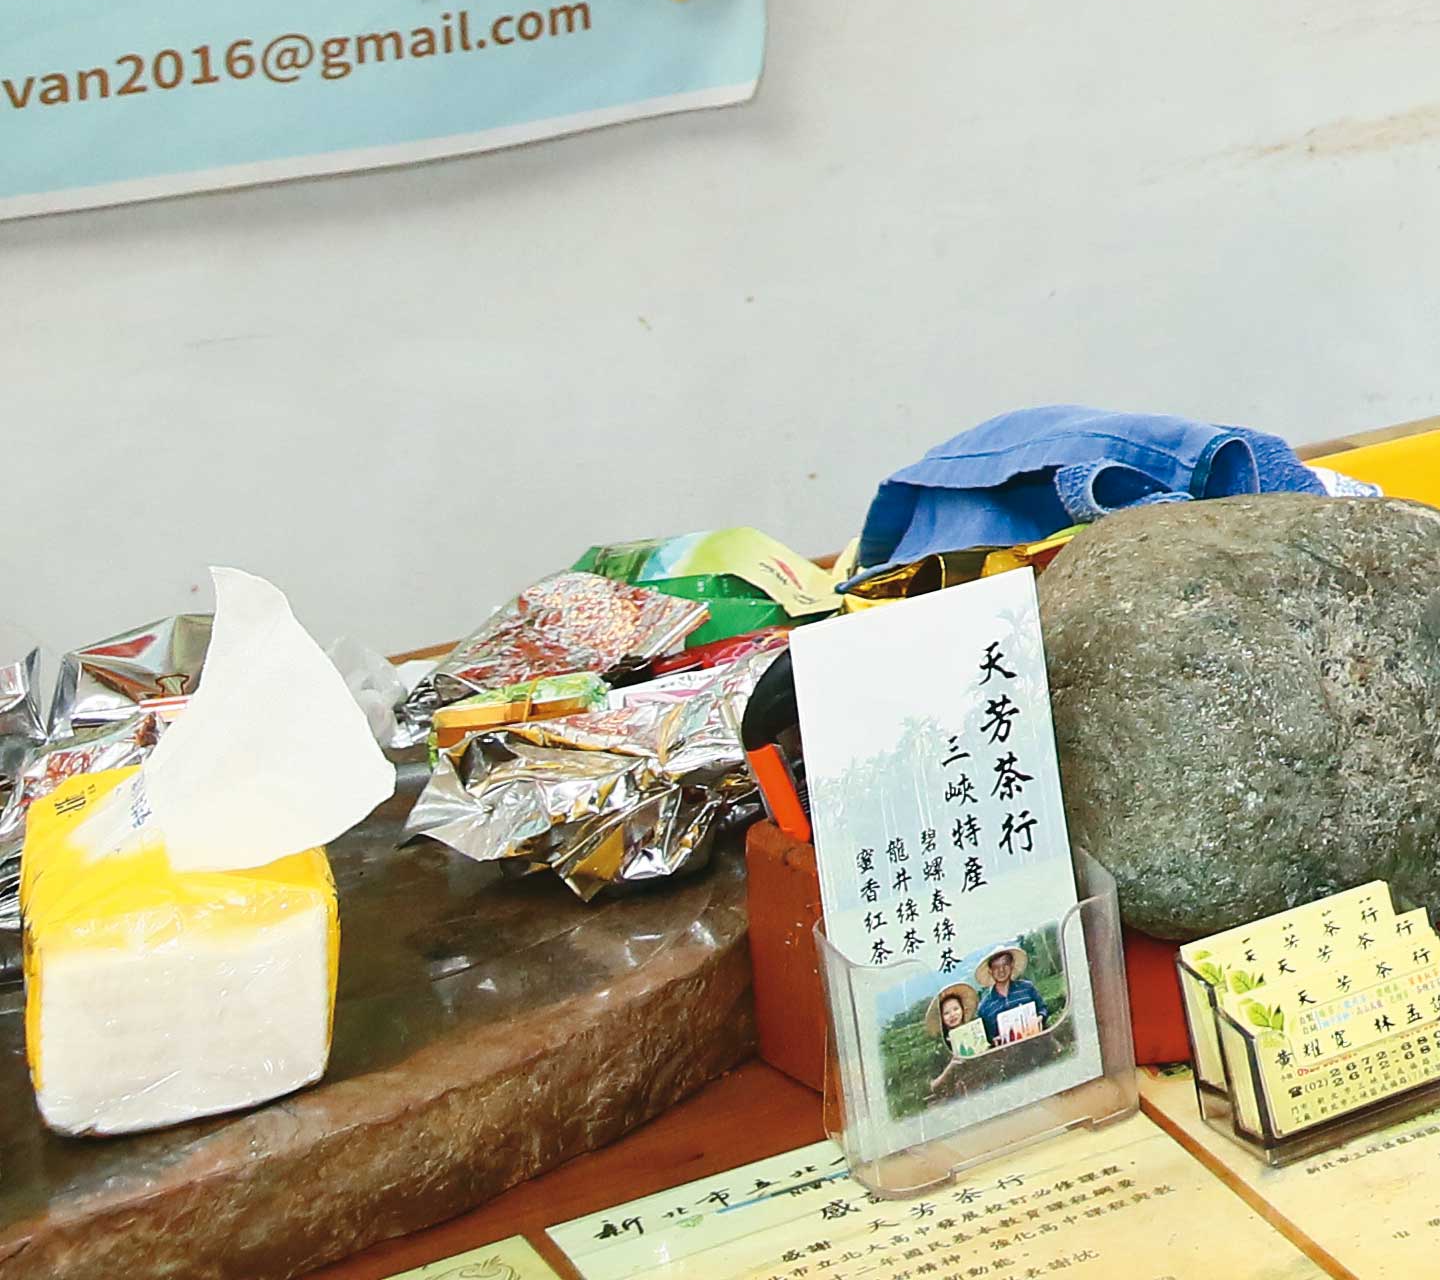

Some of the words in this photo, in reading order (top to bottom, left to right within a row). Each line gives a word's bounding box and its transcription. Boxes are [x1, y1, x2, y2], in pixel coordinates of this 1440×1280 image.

[1, 1, 593, 110] van2016@gmail.com
[977, 640, 1039, 855] 天芳茶行
[942, 735, 990, 894] 三峽特產
[854, 847, 894, 966] 蜜香紅茶
[885, 836, 927, 956] 龍井綠茶
[920, 826, 963, 976] 碧螺春綠茶
[1297, 947, 1433, 1006] 天芳茶行
[1304, 1080, 1329, 1094] (02)
[594, 1156, 845, 1240] 新北市立北
[781, 1239, 833, 1263] 感謝
[867, 1172, 1026, 1234] 天芳茶行
